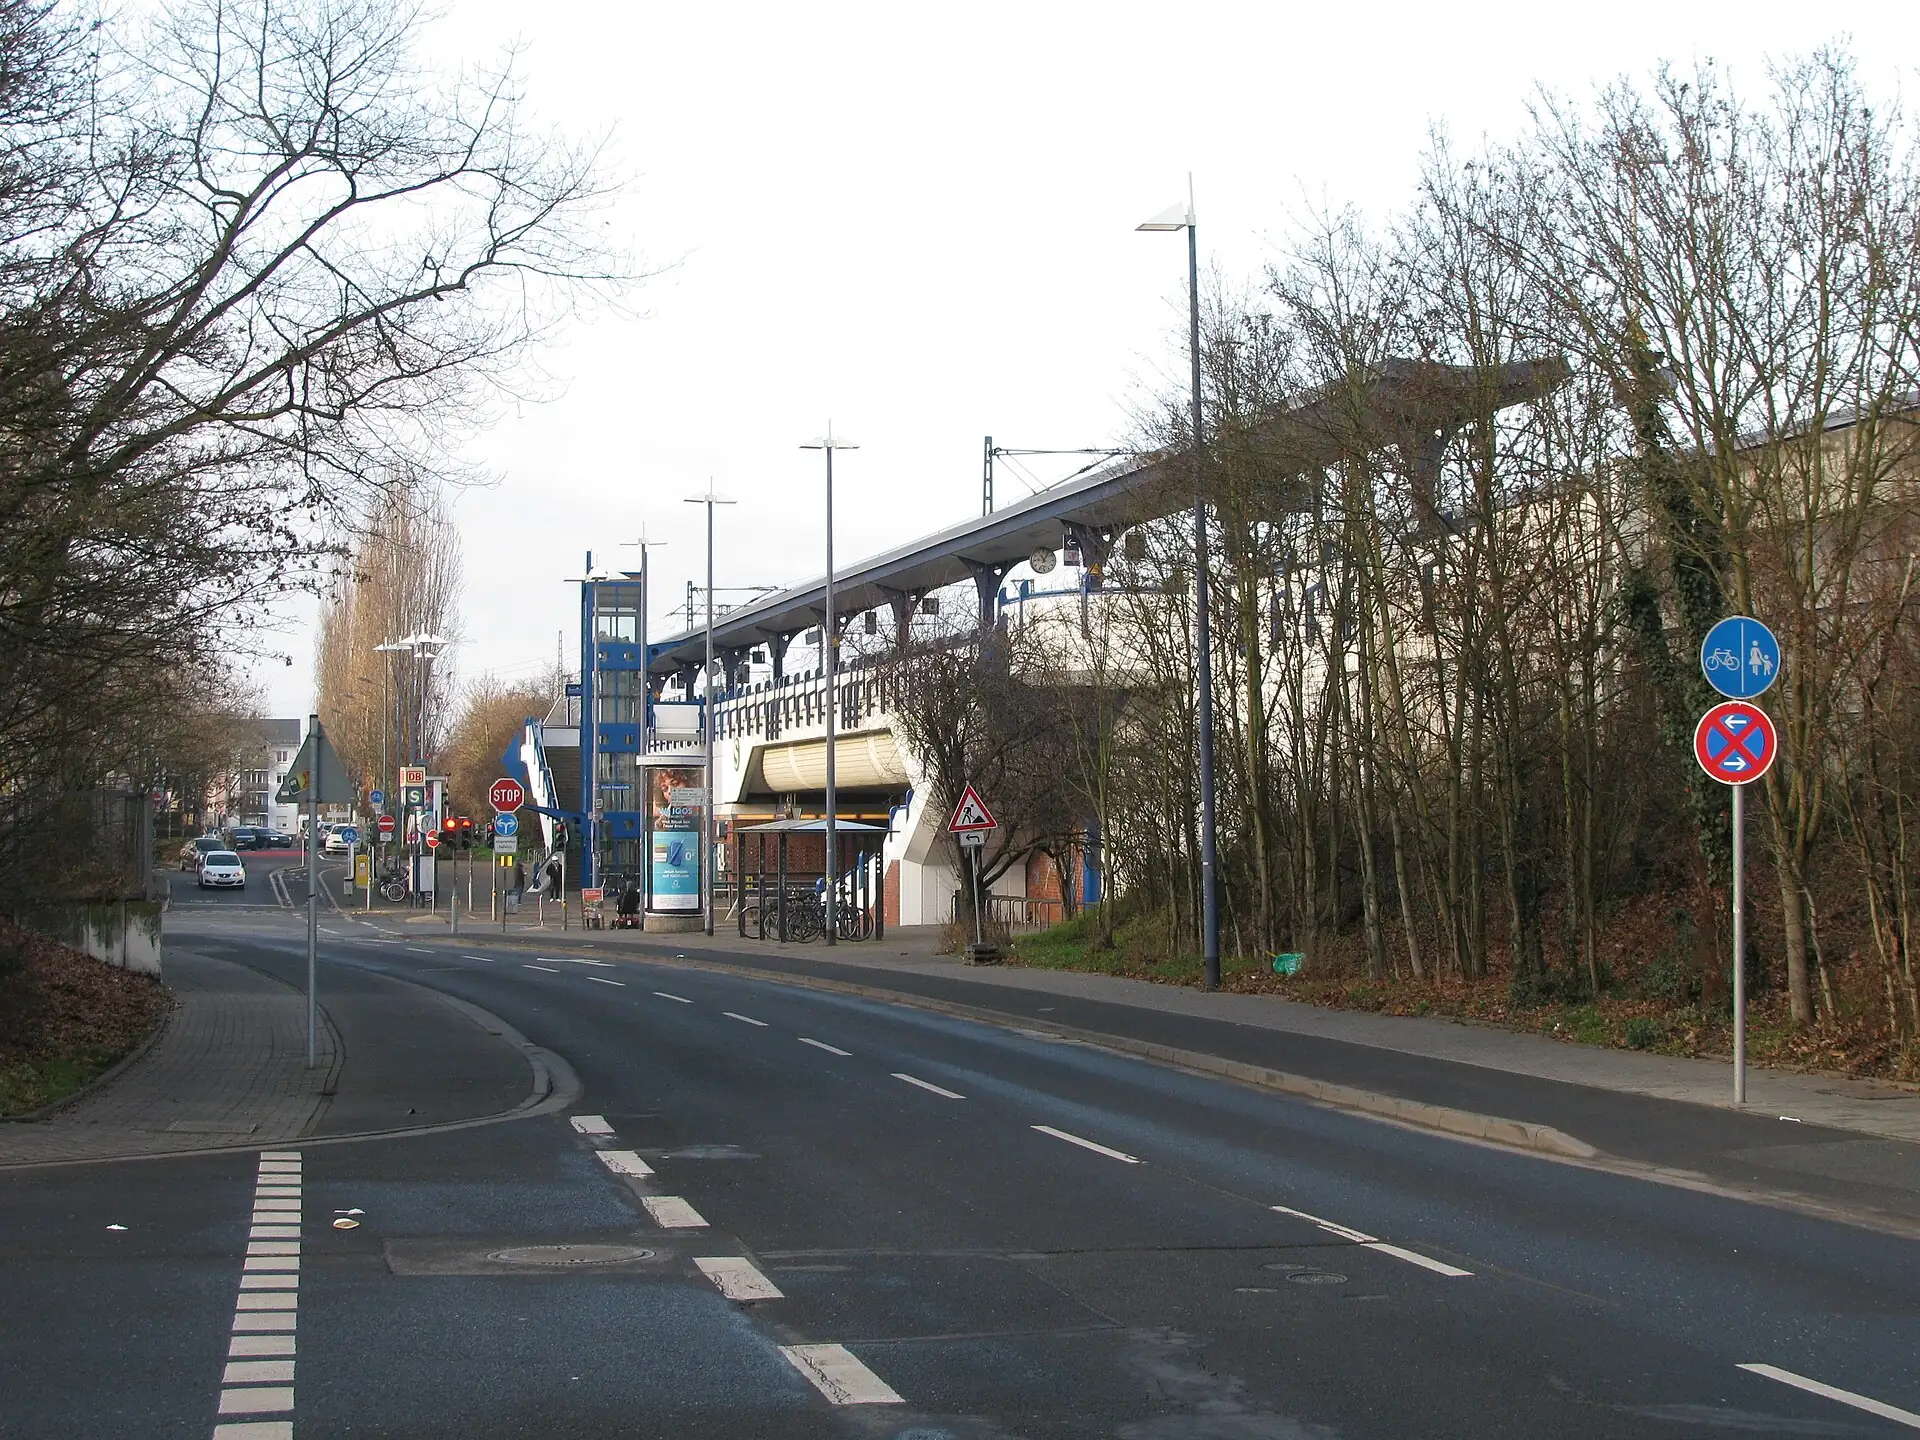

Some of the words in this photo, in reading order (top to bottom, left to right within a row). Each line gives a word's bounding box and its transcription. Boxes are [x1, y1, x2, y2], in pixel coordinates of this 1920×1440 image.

[408, 772, 422, 781] DB
[409, 790, 420, 803] S
[493, 789, 520, 802] STOP
[672, 807, 693, 815] IQOS
